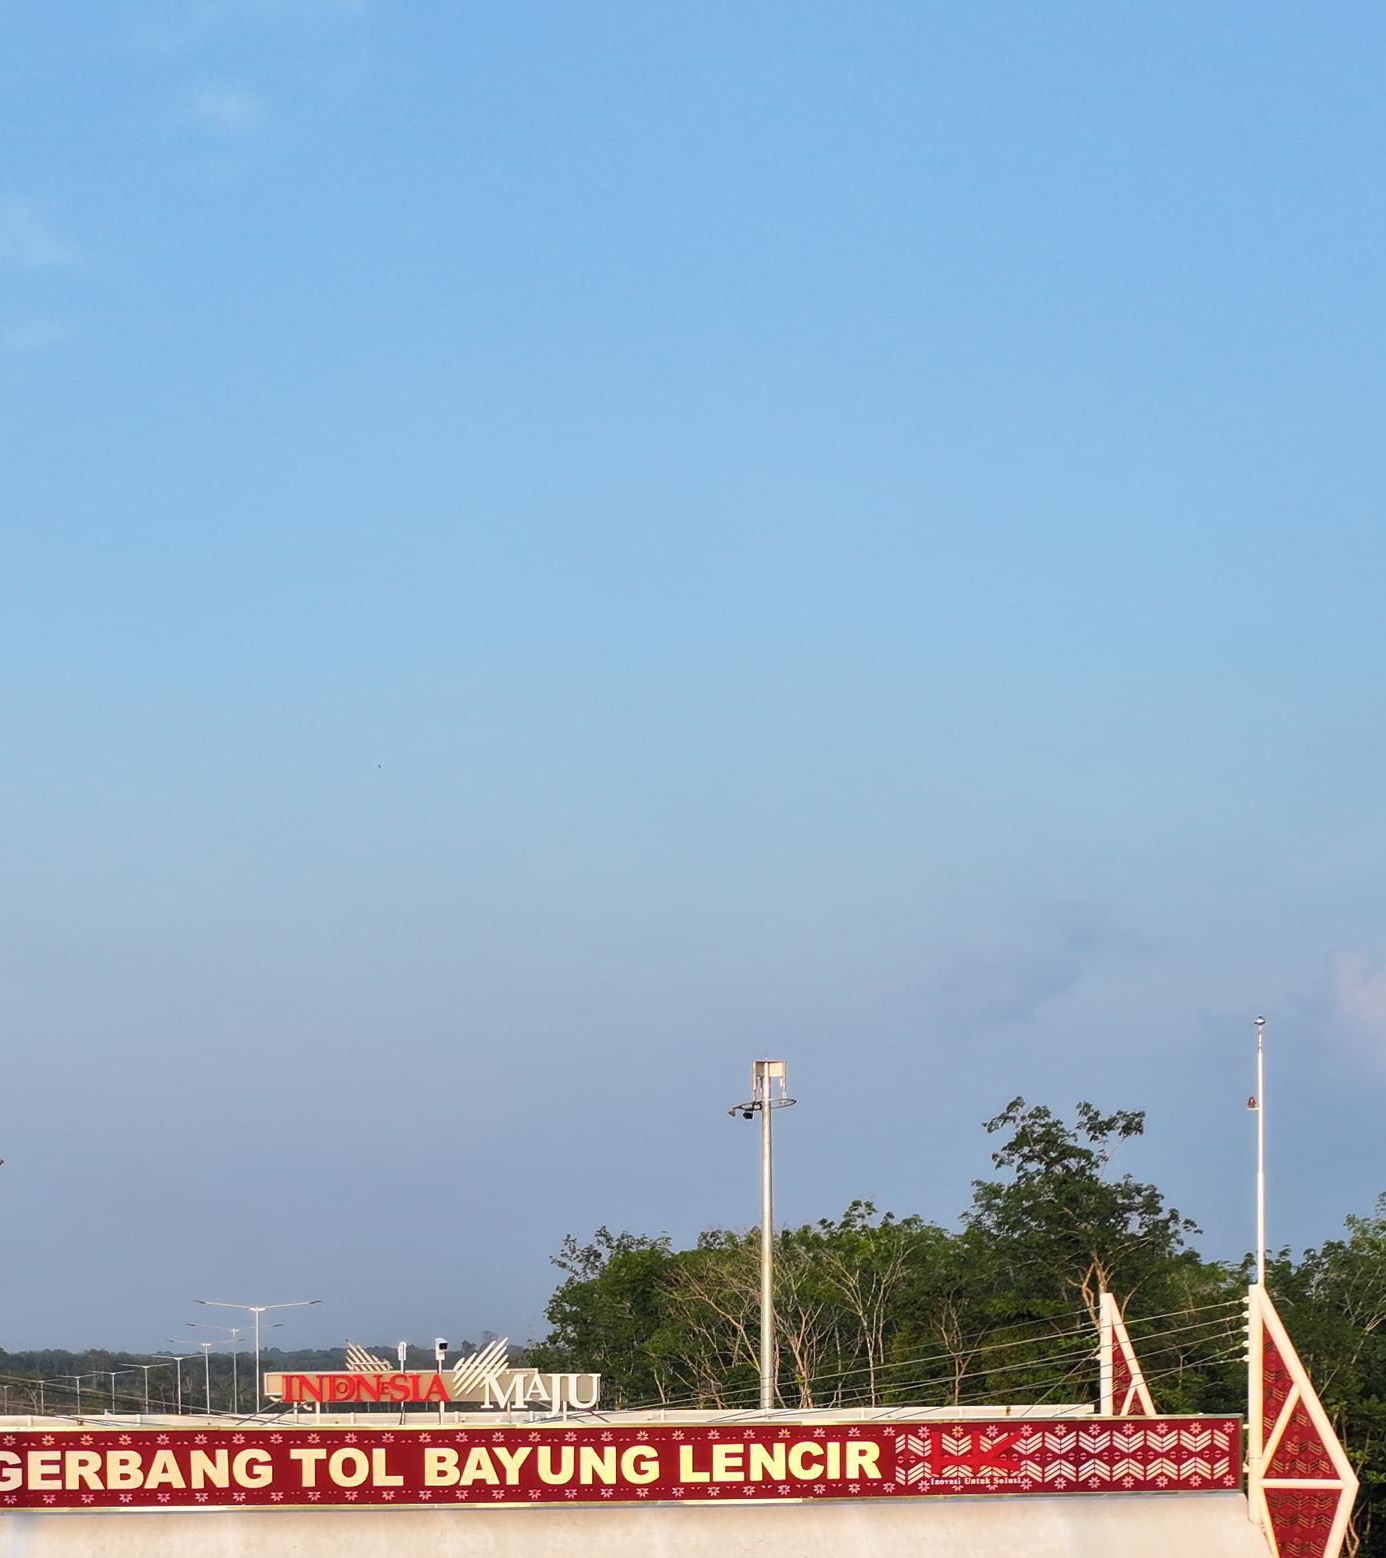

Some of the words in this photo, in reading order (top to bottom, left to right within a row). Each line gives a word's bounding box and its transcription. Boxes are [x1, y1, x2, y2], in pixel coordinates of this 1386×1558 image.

[480, 1373, 602, 1417] MAJU
[291, 1446, 404, 1489] TOL
[424, 1444, 661, 1488] BAYUNG
[679, 1440, 882, 1484] LENCIR
[930, 1477, 961, 1486] Inovasi
